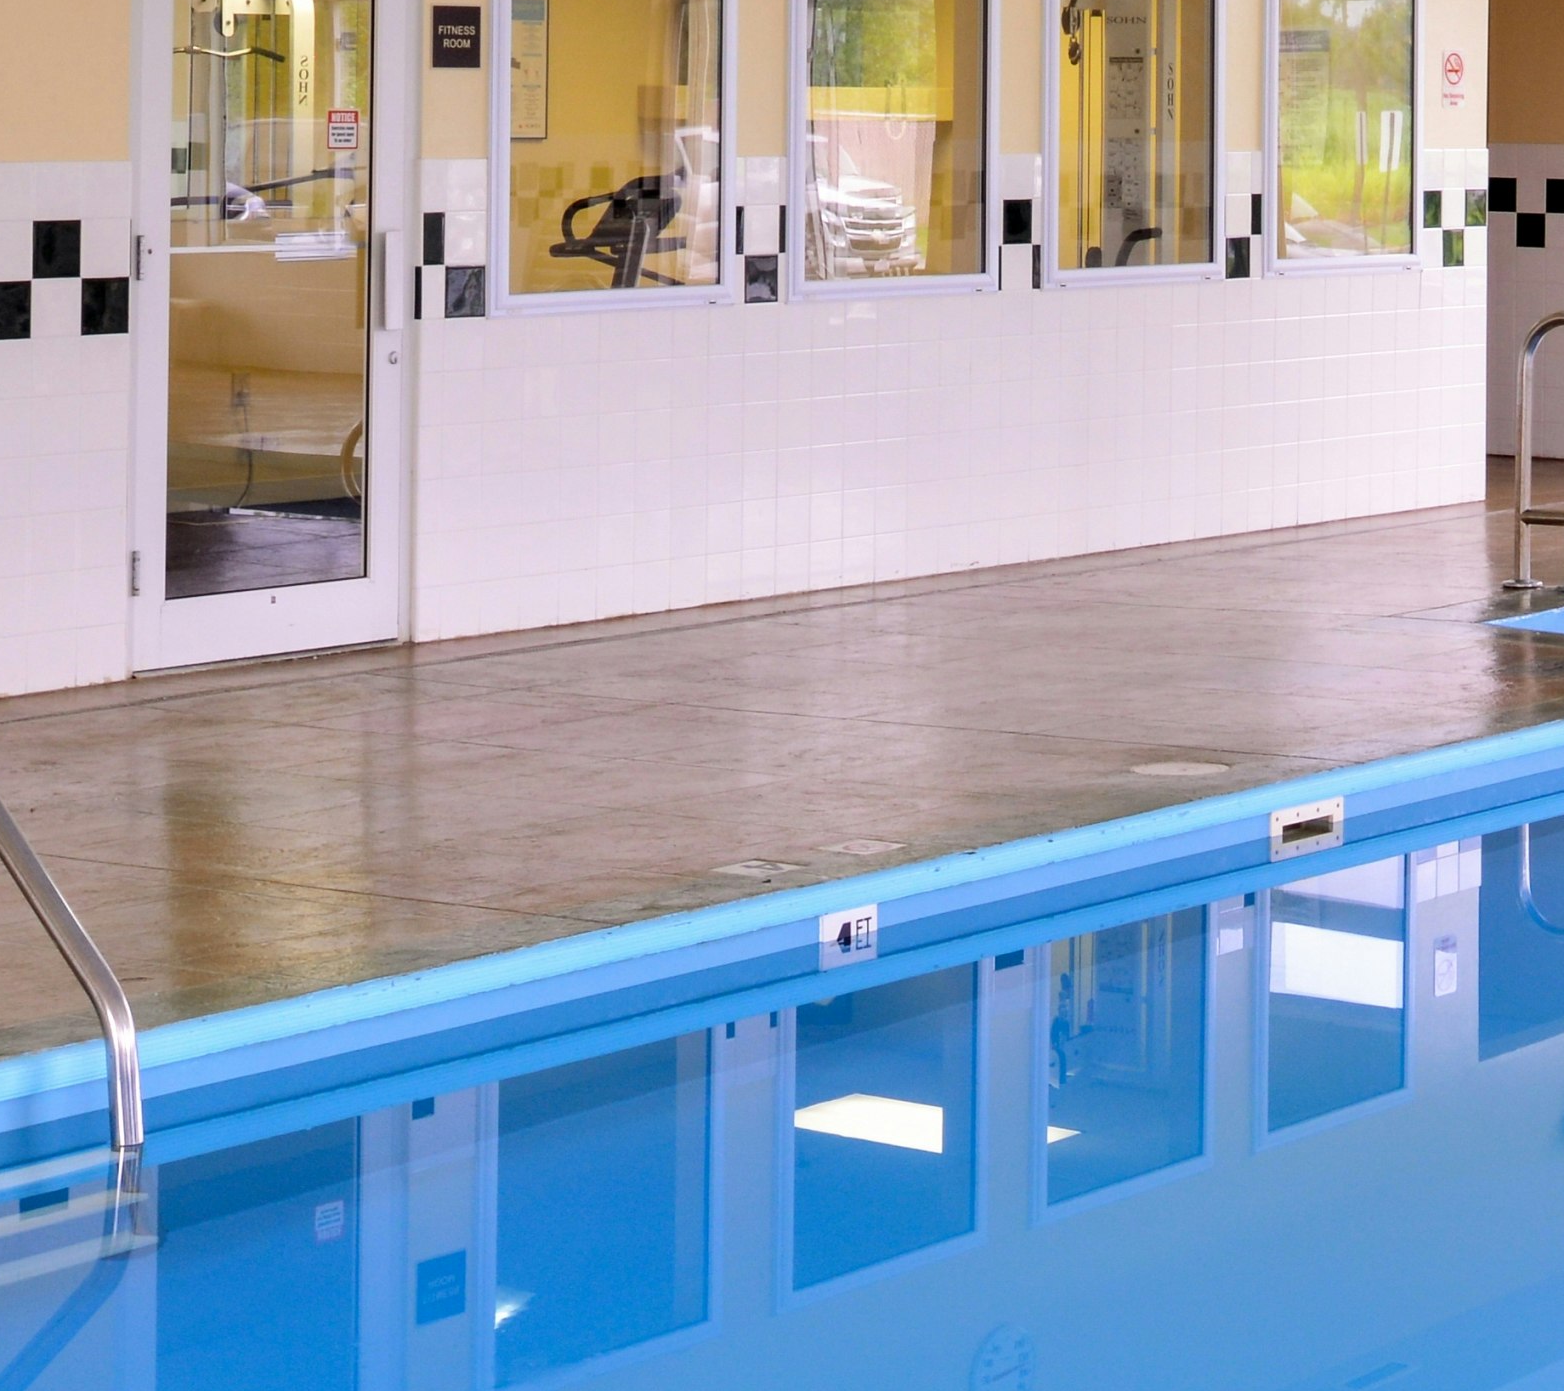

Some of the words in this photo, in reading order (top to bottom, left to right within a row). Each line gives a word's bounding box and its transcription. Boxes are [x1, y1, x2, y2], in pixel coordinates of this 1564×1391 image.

[1106, 16, 1147, 24] SOHN
[438, 25, 476, 35] FITNESS
[443, 38, 471, 48] ROOM
